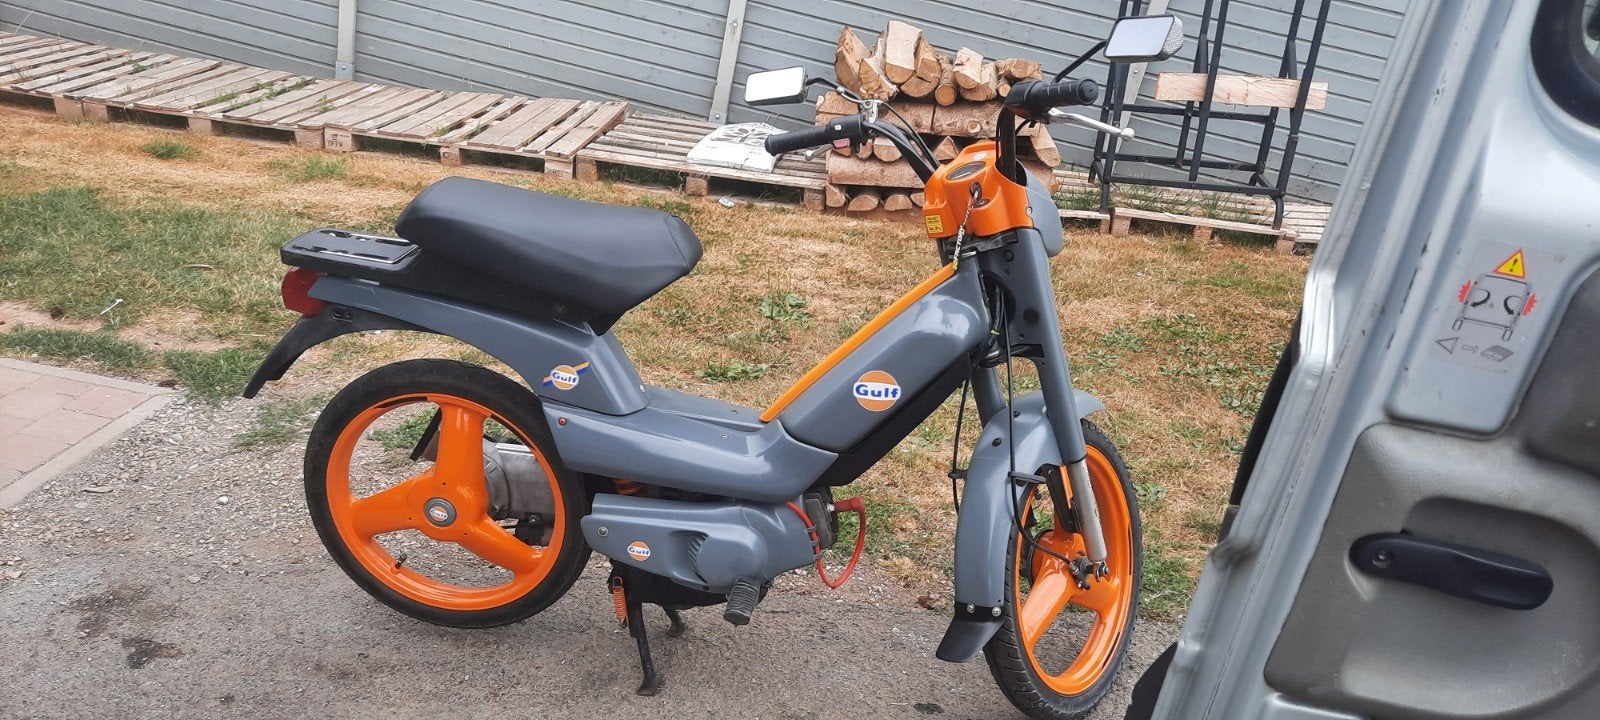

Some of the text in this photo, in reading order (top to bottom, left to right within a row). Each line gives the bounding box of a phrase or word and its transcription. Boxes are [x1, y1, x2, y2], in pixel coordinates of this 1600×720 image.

[552, 371, 577, 384] Gulf
[855, 383, 899, 399] Gulf
[629, 546, 650, 556] Gulf
